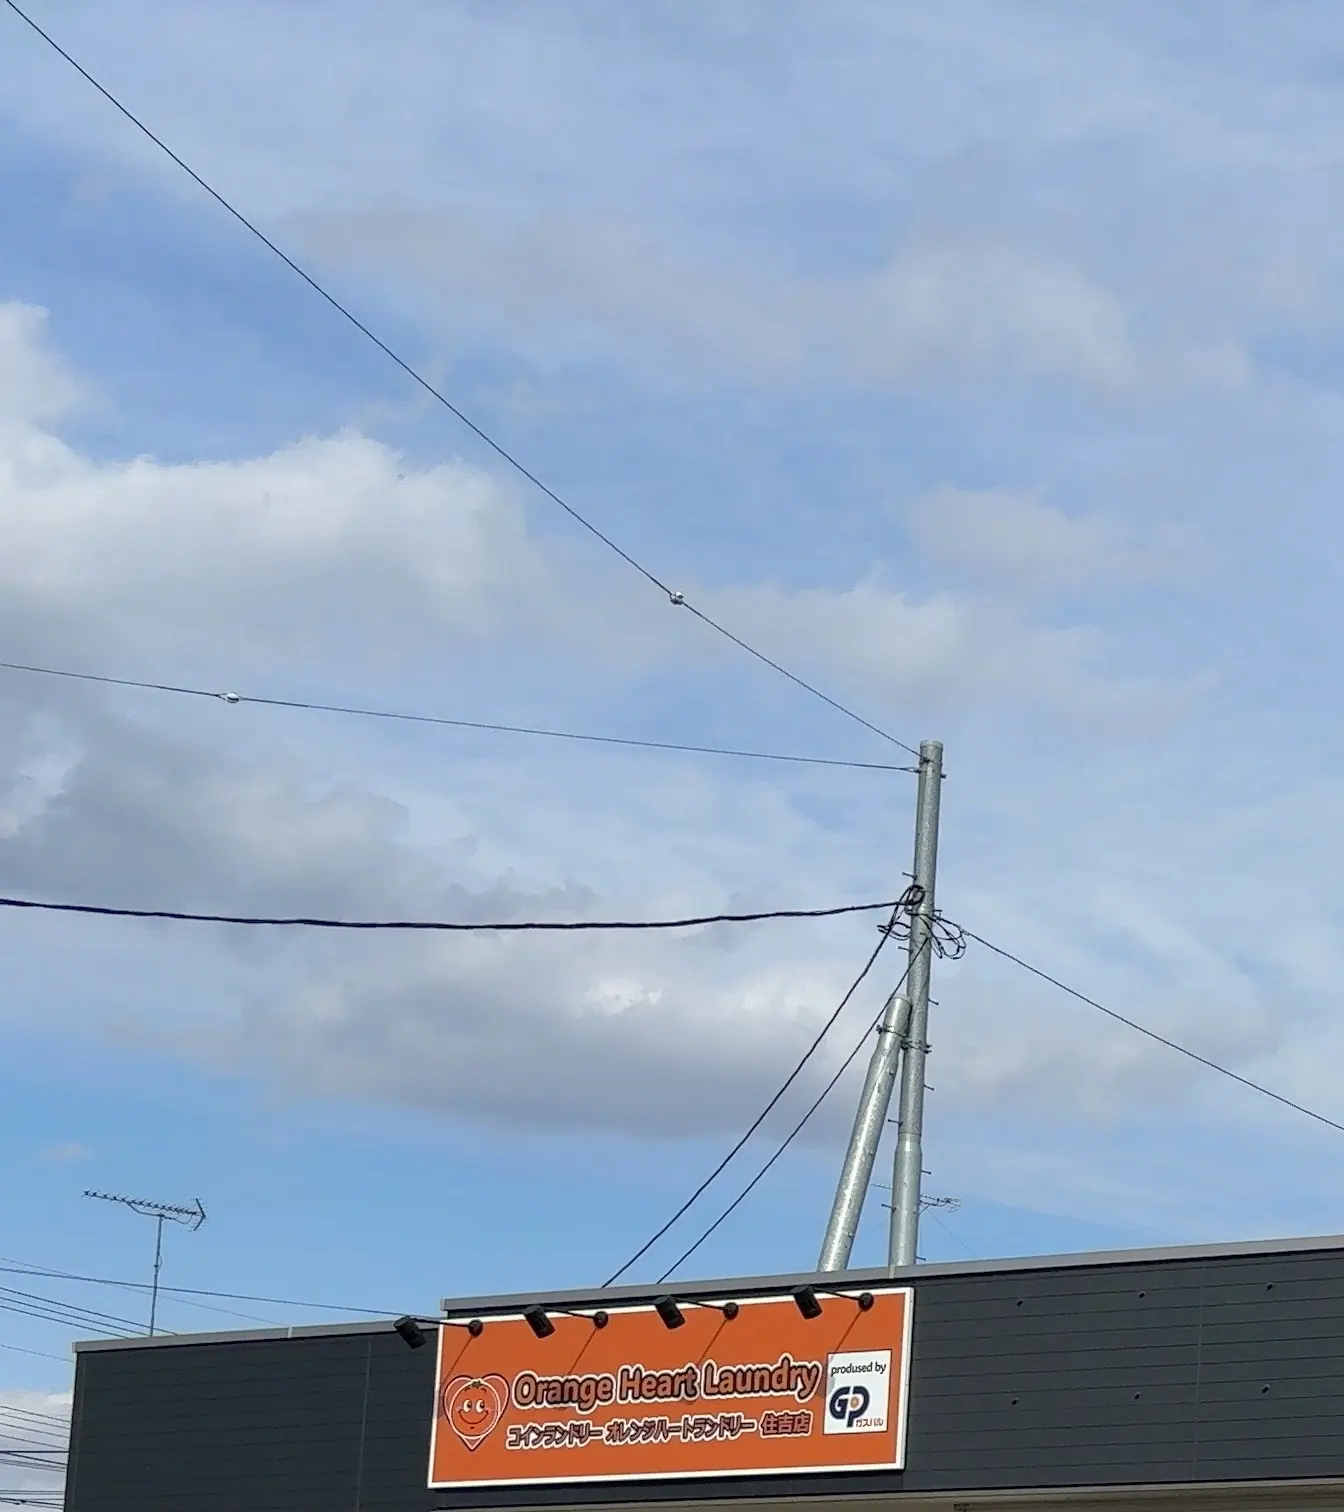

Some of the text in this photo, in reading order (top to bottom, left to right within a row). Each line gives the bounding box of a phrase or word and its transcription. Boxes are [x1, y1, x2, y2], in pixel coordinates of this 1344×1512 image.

[513, 1355, 820, 1413] Orange Heart Laundry
[831, 1361, 887, 1377] prodused by
[508, 1411, 811, 1447] コインランドリー オレンジハートランドリー 住吉店
